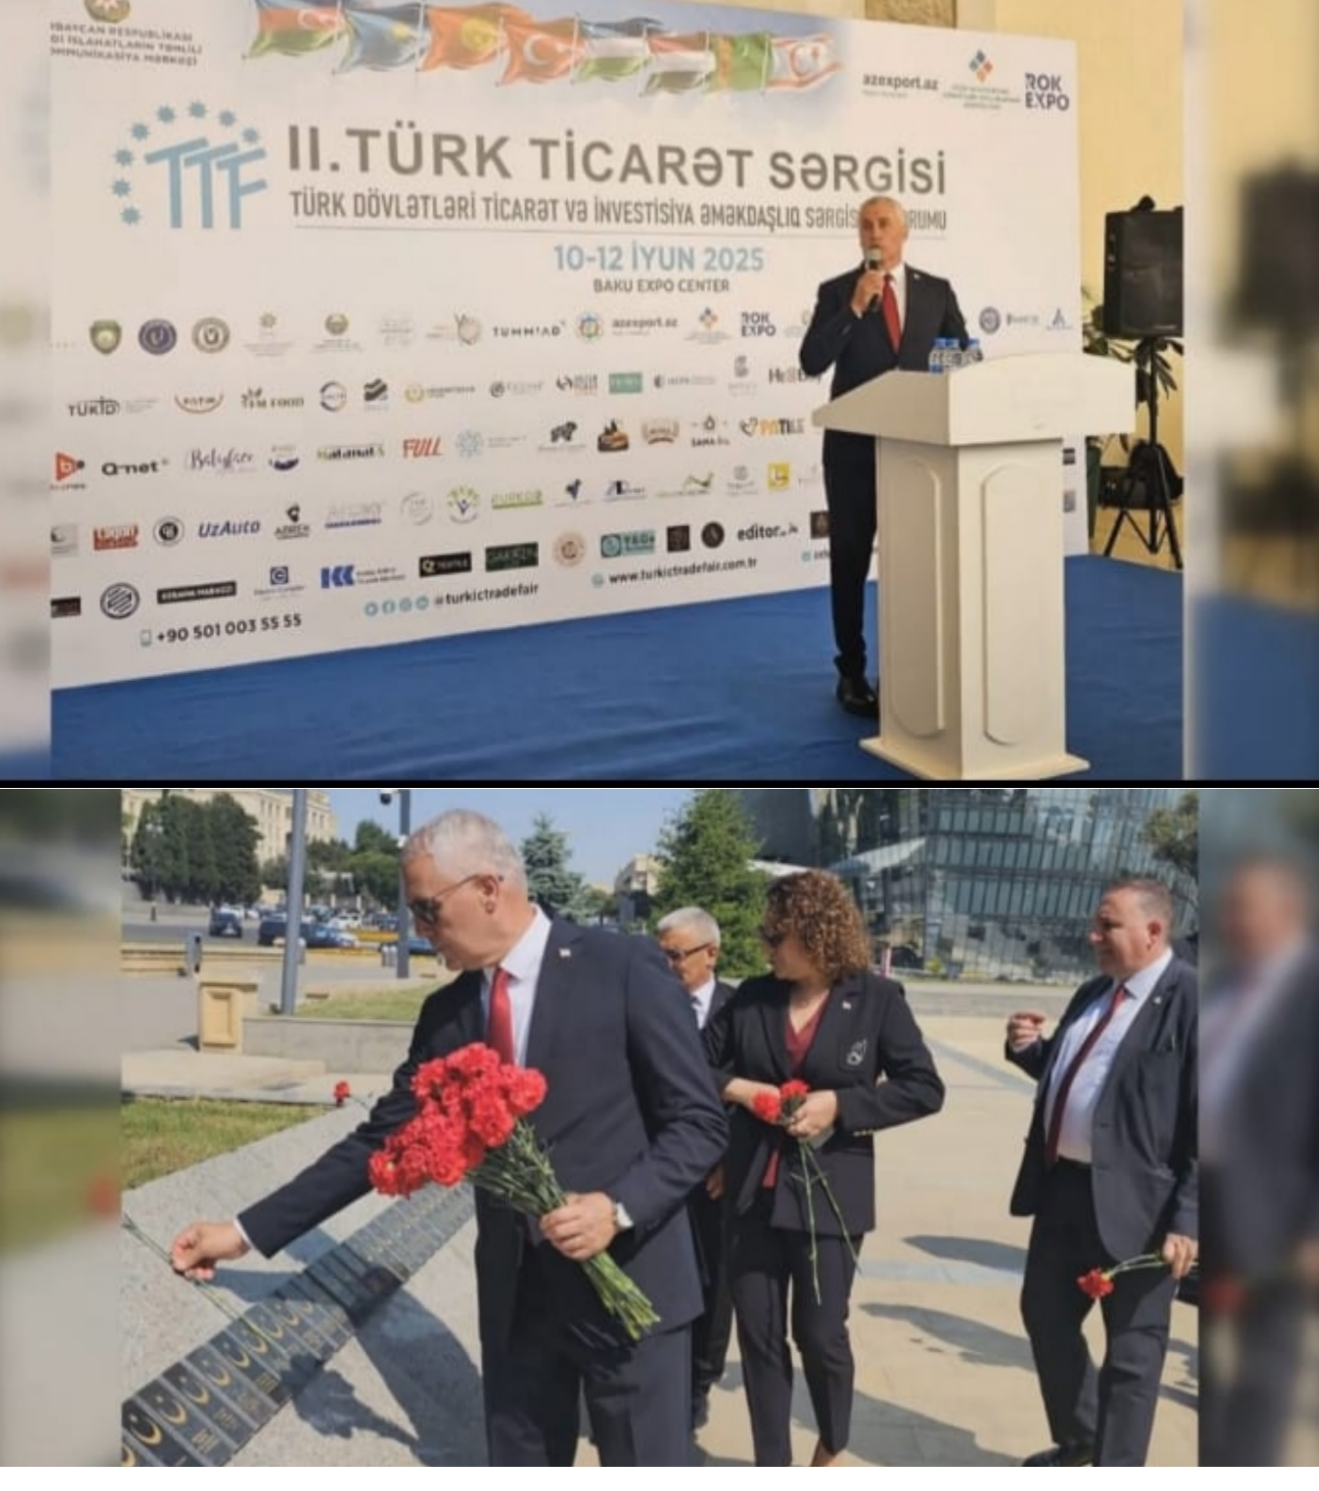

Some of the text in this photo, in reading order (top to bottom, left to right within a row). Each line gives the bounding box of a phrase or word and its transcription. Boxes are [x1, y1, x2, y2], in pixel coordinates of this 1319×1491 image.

[1025, 72, 1062, 92] ROK
[1025, 92, 1070, 111] EXPO
[529, 129, 754, 188] TİCARƏT
[769, 147, 946, 195] SƏRGİSİ
[290, 187, 346, 217] TÜRK
[353, 188, 477, 220] DÖVLƏTLƏRİ
[482, 192, 559, 222] TİCARƏT
[565, 198, 588, 224] VƏ
[594, 195, 694, 226] İNVESTİSİYA
[700, 204, 801, 232] ƏMƏKDAŞLIQ
[553, 241, 764, 272] 10-12 İYUN 2025
[593, 278, 730, 292] BAKU EXPO CENTER
[741, 325, 776, 337] EXPO
[403, 437, 444, 458] FULL
[198, 520, 261, 539] UzAuto
[157, 613, 302, 643] +90 501 003 55 55
